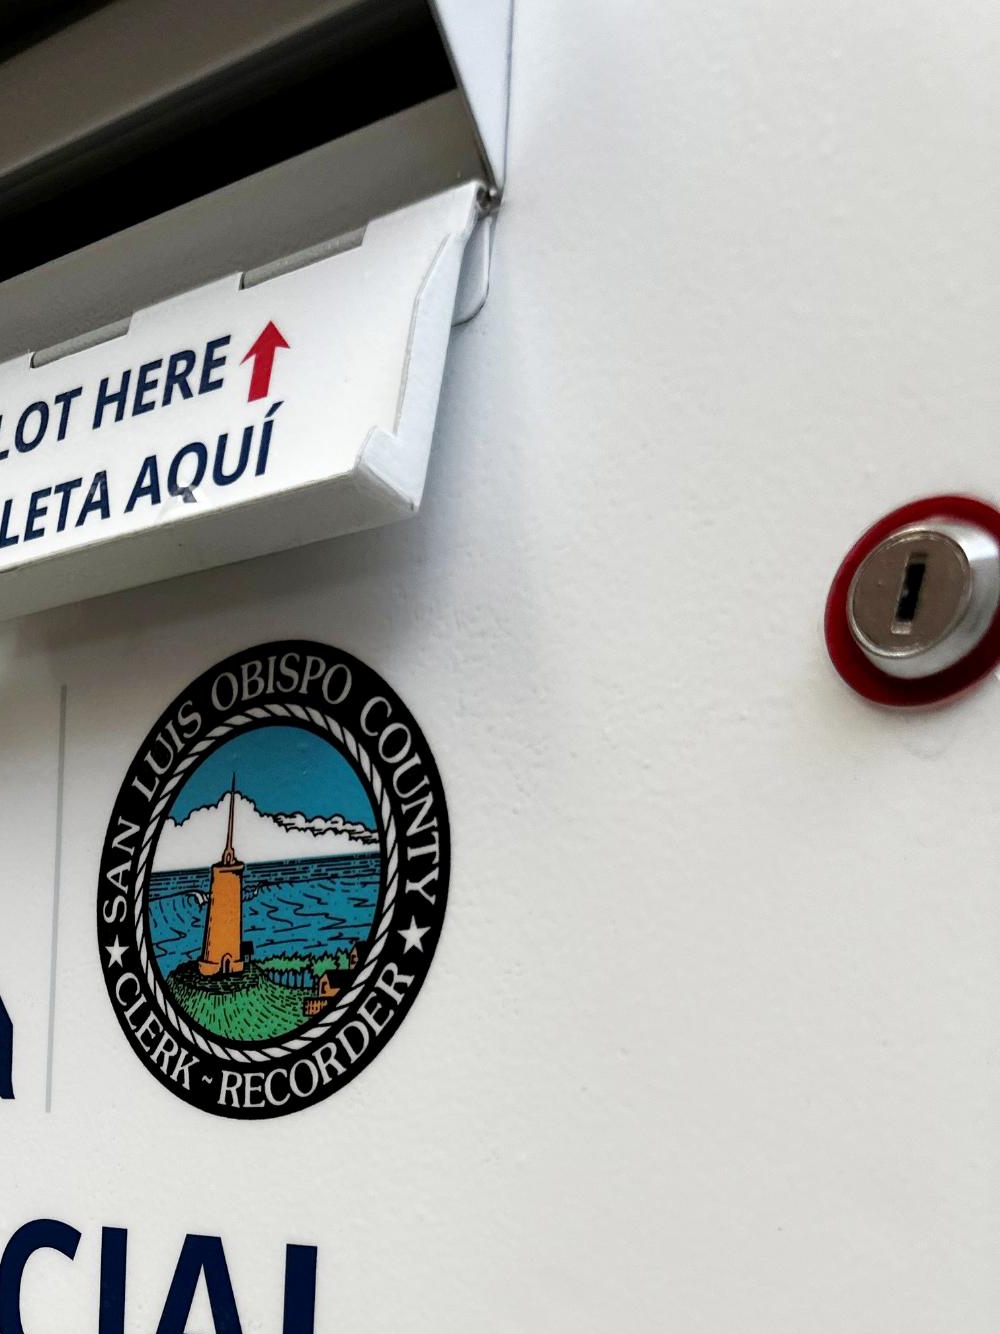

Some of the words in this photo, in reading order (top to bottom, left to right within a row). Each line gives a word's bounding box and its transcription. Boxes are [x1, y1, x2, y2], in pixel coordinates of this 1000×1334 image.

[91, 334, 231, 427] HERE
[126, 402, 284, 513] AQUÍ
[103, 816, 141, 924] SAN
[132, 700, 203, 803] LUIS
[210, 652, 353, 713] OBISPO
[359, 696, 444, 905] COUNTY
[115, 971, 203, 1090] CLERK
[217, 960, 415, 1109] RECORDER
